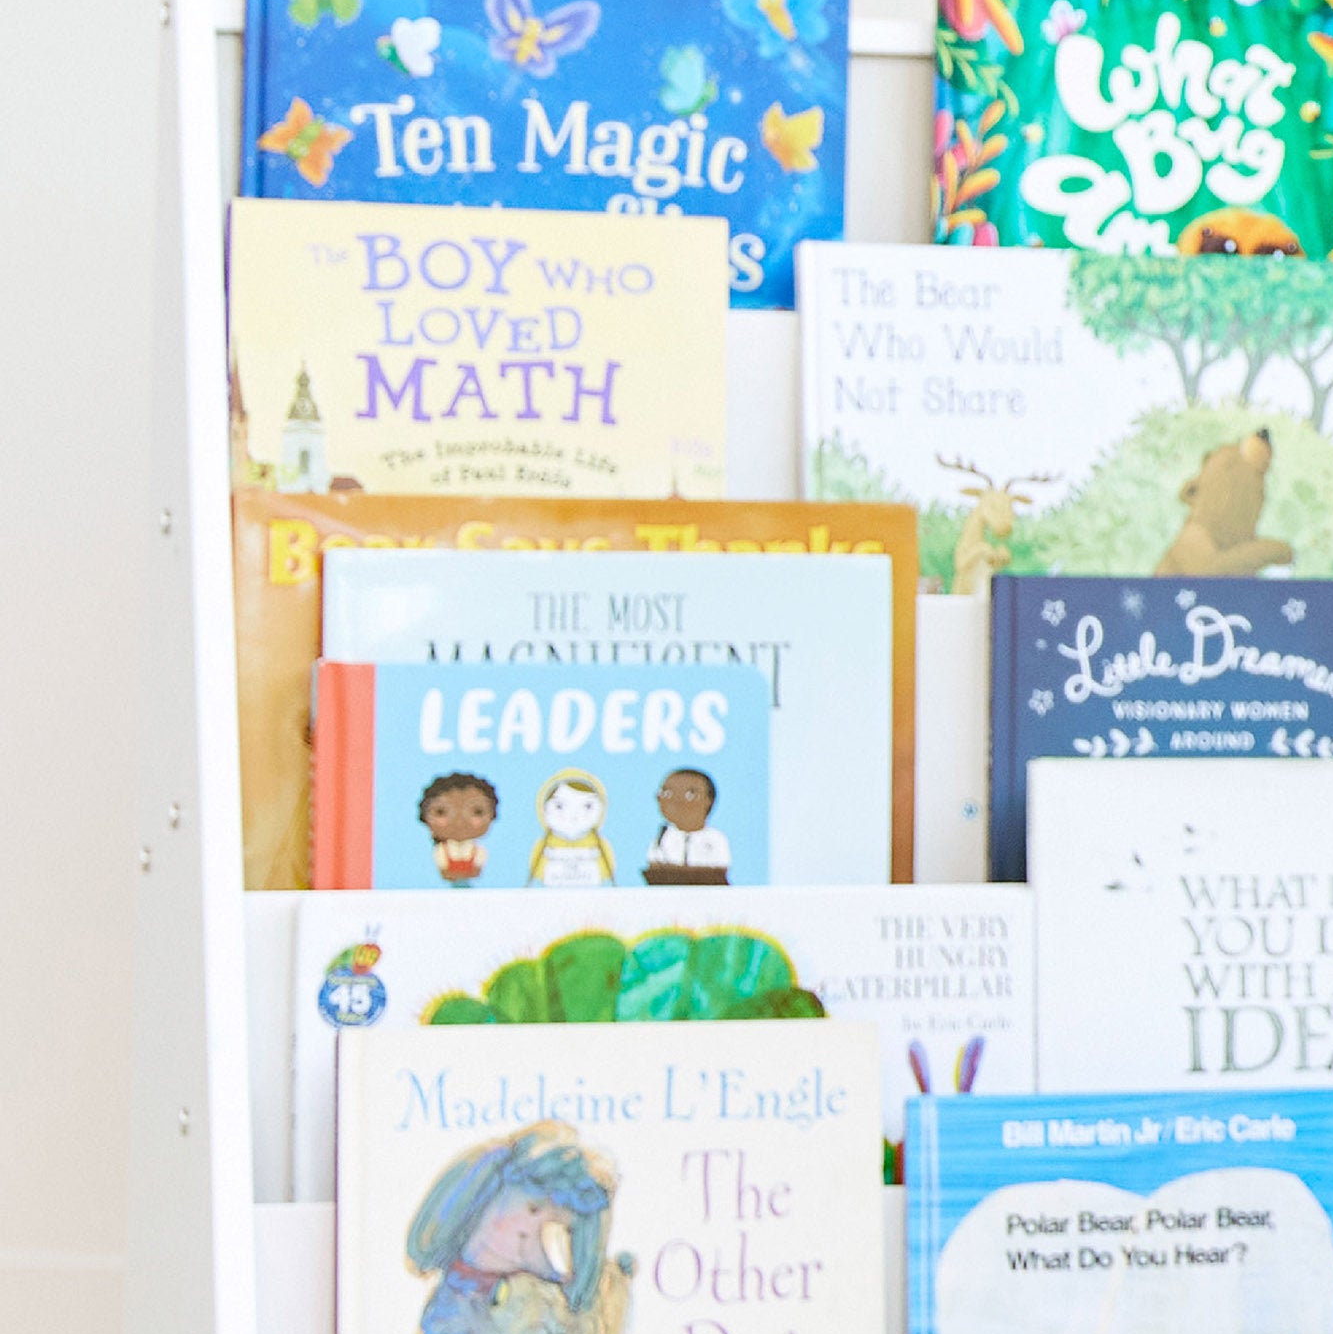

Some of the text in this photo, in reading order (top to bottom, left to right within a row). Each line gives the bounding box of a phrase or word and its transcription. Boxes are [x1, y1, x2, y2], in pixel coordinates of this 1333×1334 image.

[1054, 11, 1297, 133] What
[350, 94, 748, 199] Ten Magic
[1112, 109, 1286, 215] Bug
[356, 232, 529, 297] BOY
[535, 258, 655, 296] WHO
[832, 267, 1001, 311] The Bear
[377, 300, 583, 354] LOVED
[833, 321, 1065, 365] Who Would
[354, 353, 623, 424] MATH
[832, 374, 1030, 419] Not Share
[528, 592, 690, 634] THE MOST
[418, 687, 731, 756] LEADERS
[1111, 700, 1310, 722] VISIONARY WOMEN
[1168, 730, 1256, 752] AROUND
[1178, 873, 1318, 910] WHAT
[875, 915, 1011, 940] THE VERY
[1181, 914, 1296, 957] YOU
[1185, 962, 1317, 1000] WITH
[396, 1065, 849, 1132] Madeleine L'Engle
[1002, 1120, 1044, 1150] Bill
[1049, 1118, 1132, 1148] Martin
[1228, 1113, 1297, 1142] Carle
[681, 1149, 794, 1226] The
[1007, 1207, 1277, 1236] Polar Bear, Polar Bear,
[652, 1230, 824, 1304] Other
[1007, 1243, 1248, 1271] What Do You Hear?
